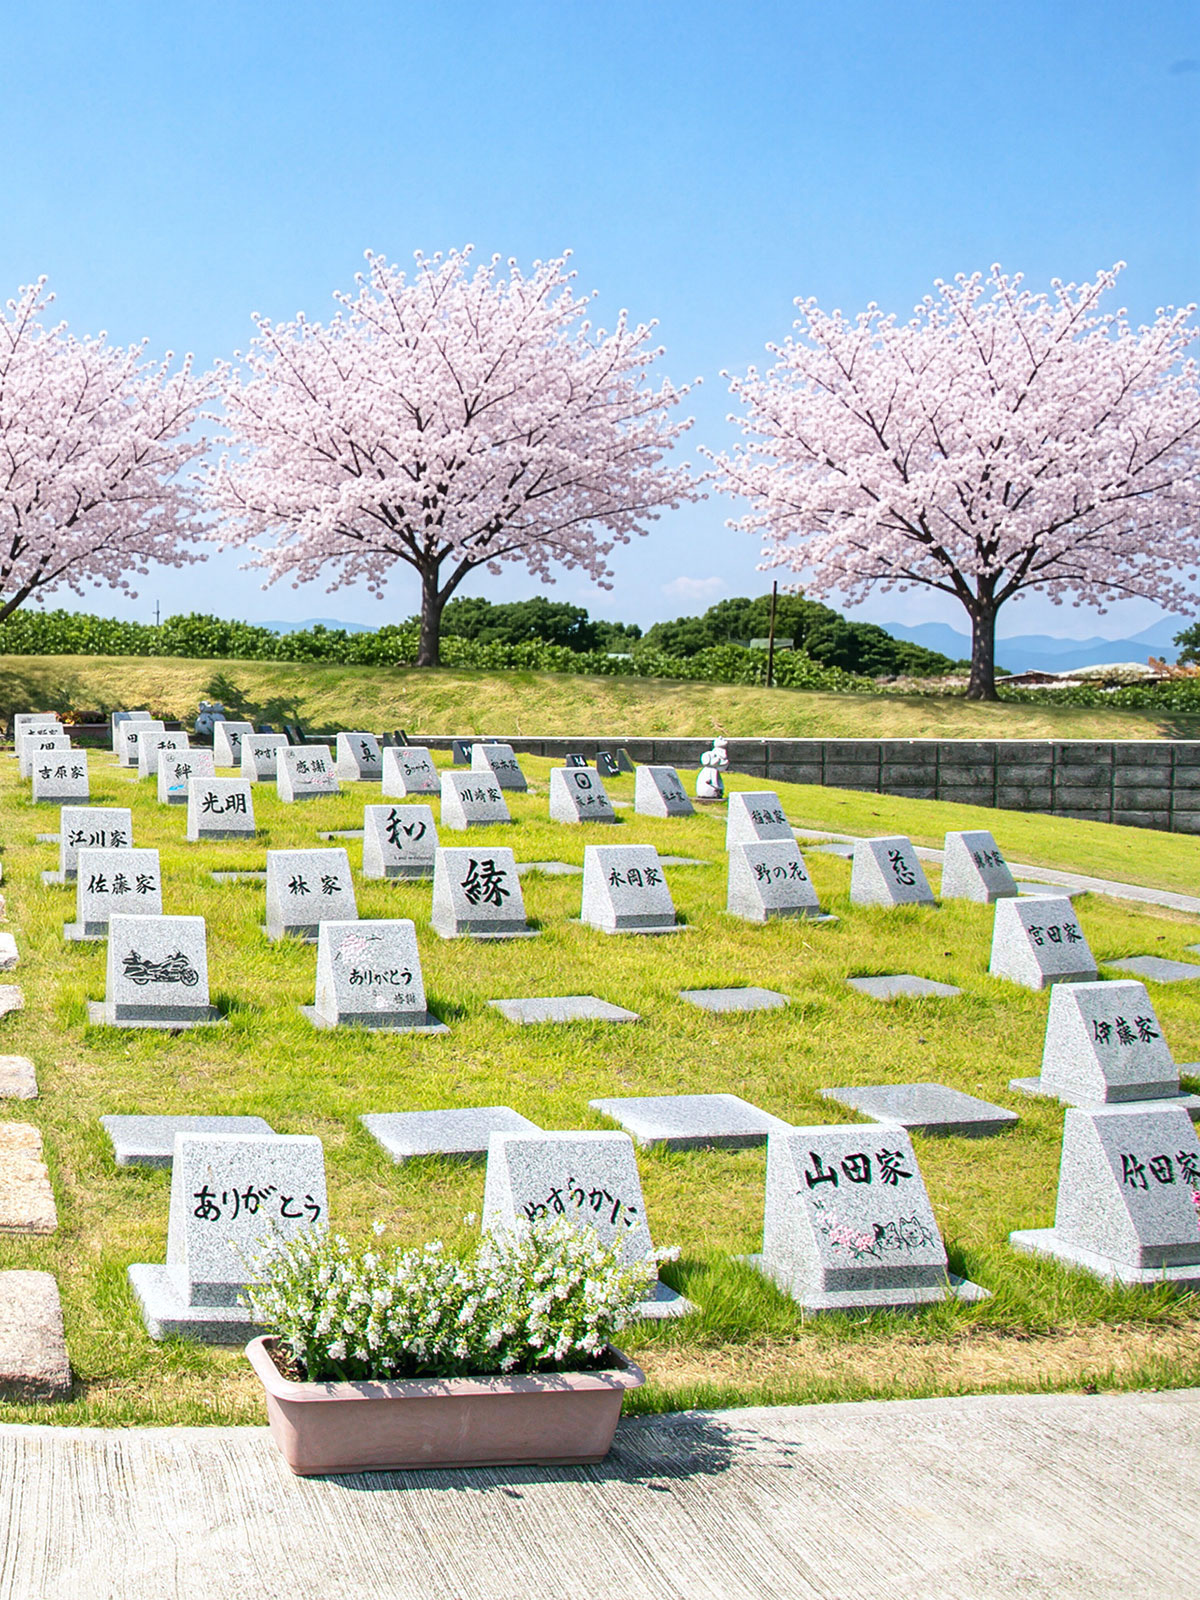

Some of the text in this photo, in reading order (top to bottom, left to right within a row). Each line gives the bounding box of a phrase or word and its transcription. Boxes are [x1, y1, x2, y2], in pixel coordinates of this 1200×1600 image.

[39, 766, 85, 780] 吉原家
[174, 763, 192, 779] 絆
[296, 759, 326, 774] 感謝
[202, 791, 248, 814] 光明
[68, 830, 128, 848] 江川家
[87, 873, 157, 895] 佐藤家
[288, 874, 343, 896] 林家
[460, 858, 512, 907] 縁
[608, 867, 663, 888] 永岡家
[753, 862, 807, 885] 野の花
[1028, 922, 1083, 947] 宮田家
[348, 967, 413, 987] ありがとう
[1092, 1015, 1160, 1046] 伊藤家
[804, 1147, 914, 1190] 山田家
[1120, 1150, 1200, 1191] 竹田家
[193, 1184, 321, 1223] ありがとう
[521, 1177, 638, 1227] やすらかに
